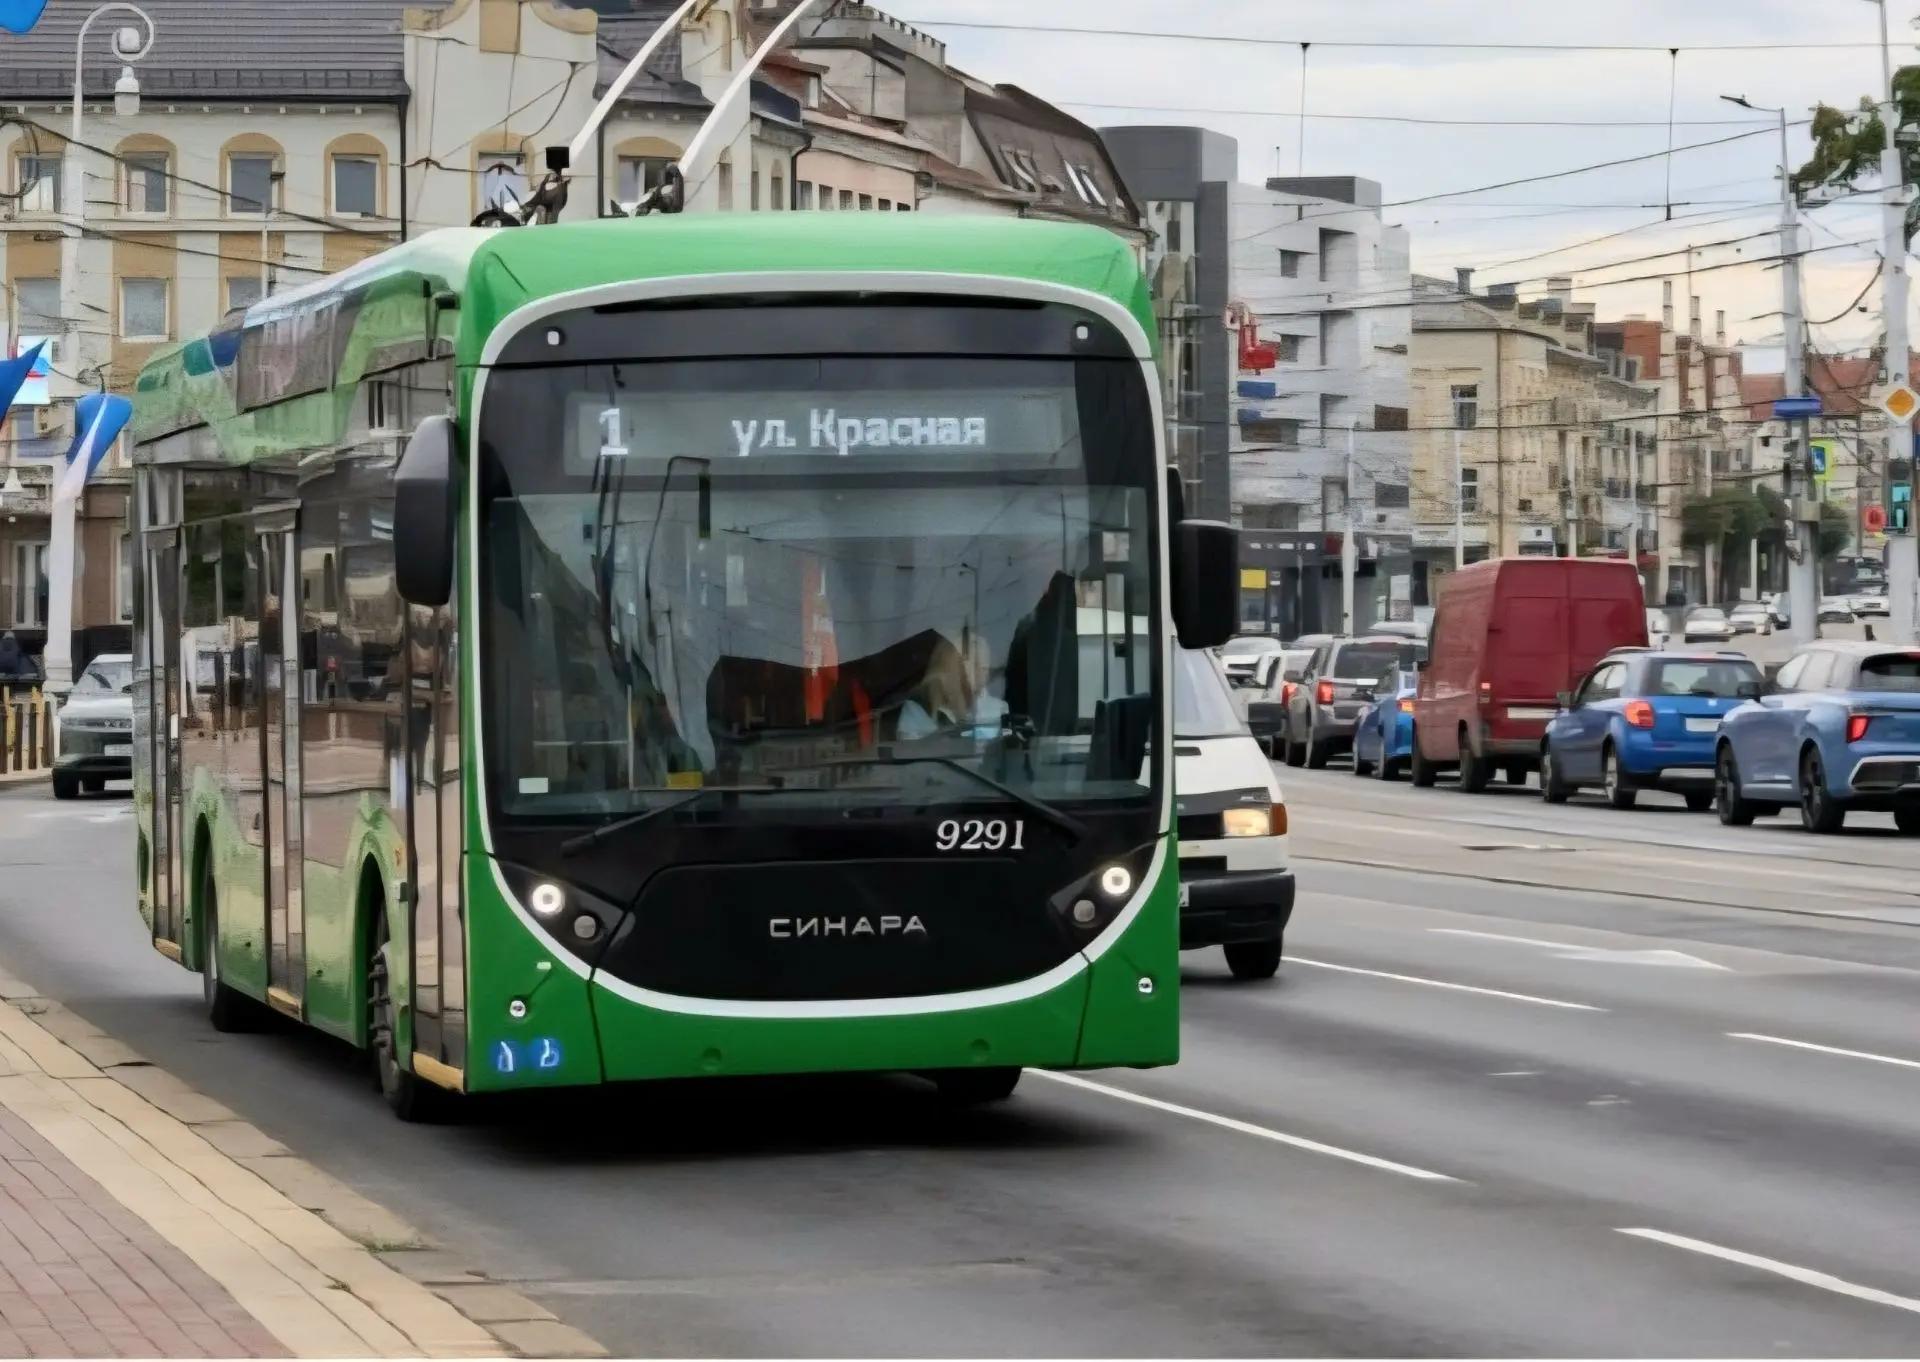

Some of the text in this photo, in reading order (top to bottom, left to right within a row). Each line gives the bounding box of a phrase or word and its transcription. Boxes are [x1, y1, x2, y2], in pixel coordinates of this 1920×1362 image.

[599, 408, 985, 456] 1 ул. Красная
[935, 819, 1025, 851] 9291
[769, 915, 927, 938] СИНАРА
